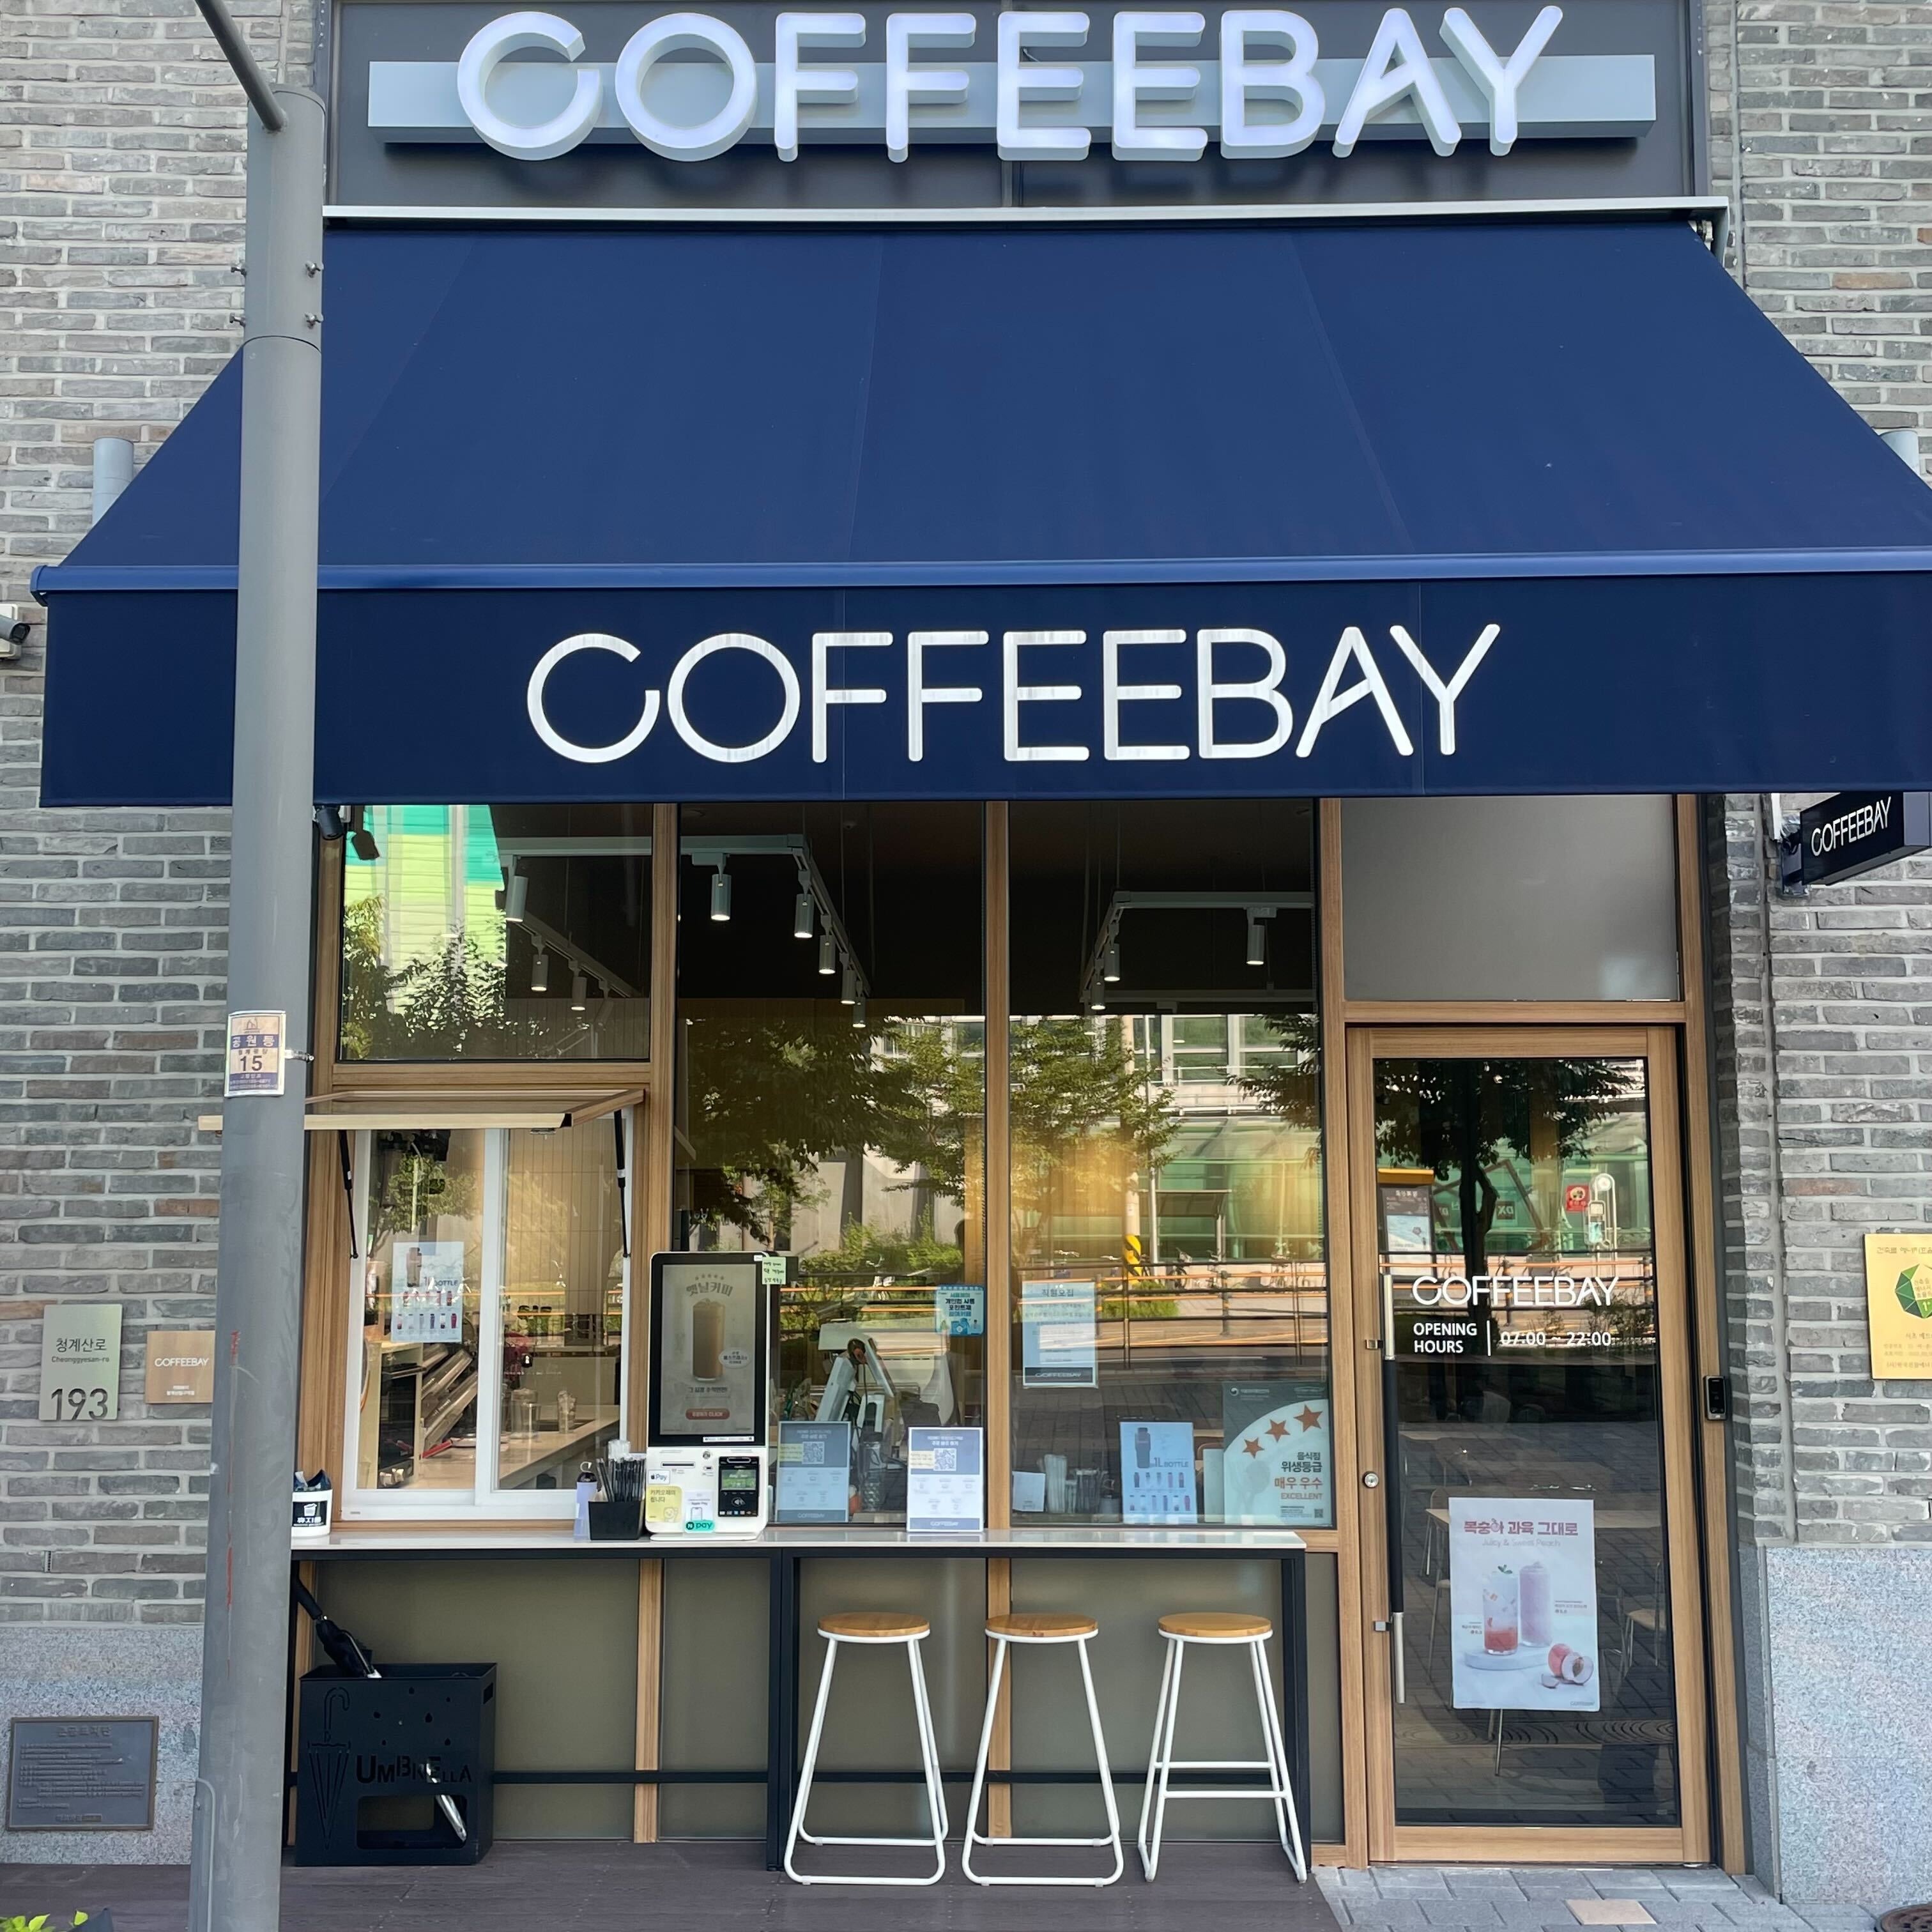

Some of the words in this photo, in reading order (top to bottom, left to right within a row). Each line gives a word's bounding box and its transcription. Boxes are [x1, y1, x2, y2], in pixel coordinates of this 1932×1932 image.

[457, 5, 1563, 162] COFFEEBAY
[526, 624, 1501, 763] COFFEEBAY
[1811, 796, 1891, 857] COFFEEBAY
[240, 1055, 263, 1072] 15
[1412, 1276, 1619, 1307] COFFEEBAY
[1413, 1322, 1478, 1336] OPENING
[56, 1338, 107, 1353] 청계산로
[1500, 1331, 1546, 1346] 07:00
[1566, 1331, 1612, 1346] 22:00
[1414, 1340, 1464, 1353] HOURS
[51, 1356, 110, 1364] Cheonggyesan-ro
[154, 1357, 210, 1367] COFFEEBAY
[51, 1388, 108, 1421] 193
[1297, 1452, 1321, 1460] 음식점
[1281, 1461, 1322, 1473] 위생등급
[1274, 1476, 1298, 1489] 매우
[1300, 1476, 1323, 1489] 우수
[1464, 1519, 1504, 1535] 복숭아
[1508, 1521, 1534, 1535] 과육
[1537, 1522, 1578, 1536] 그대로
